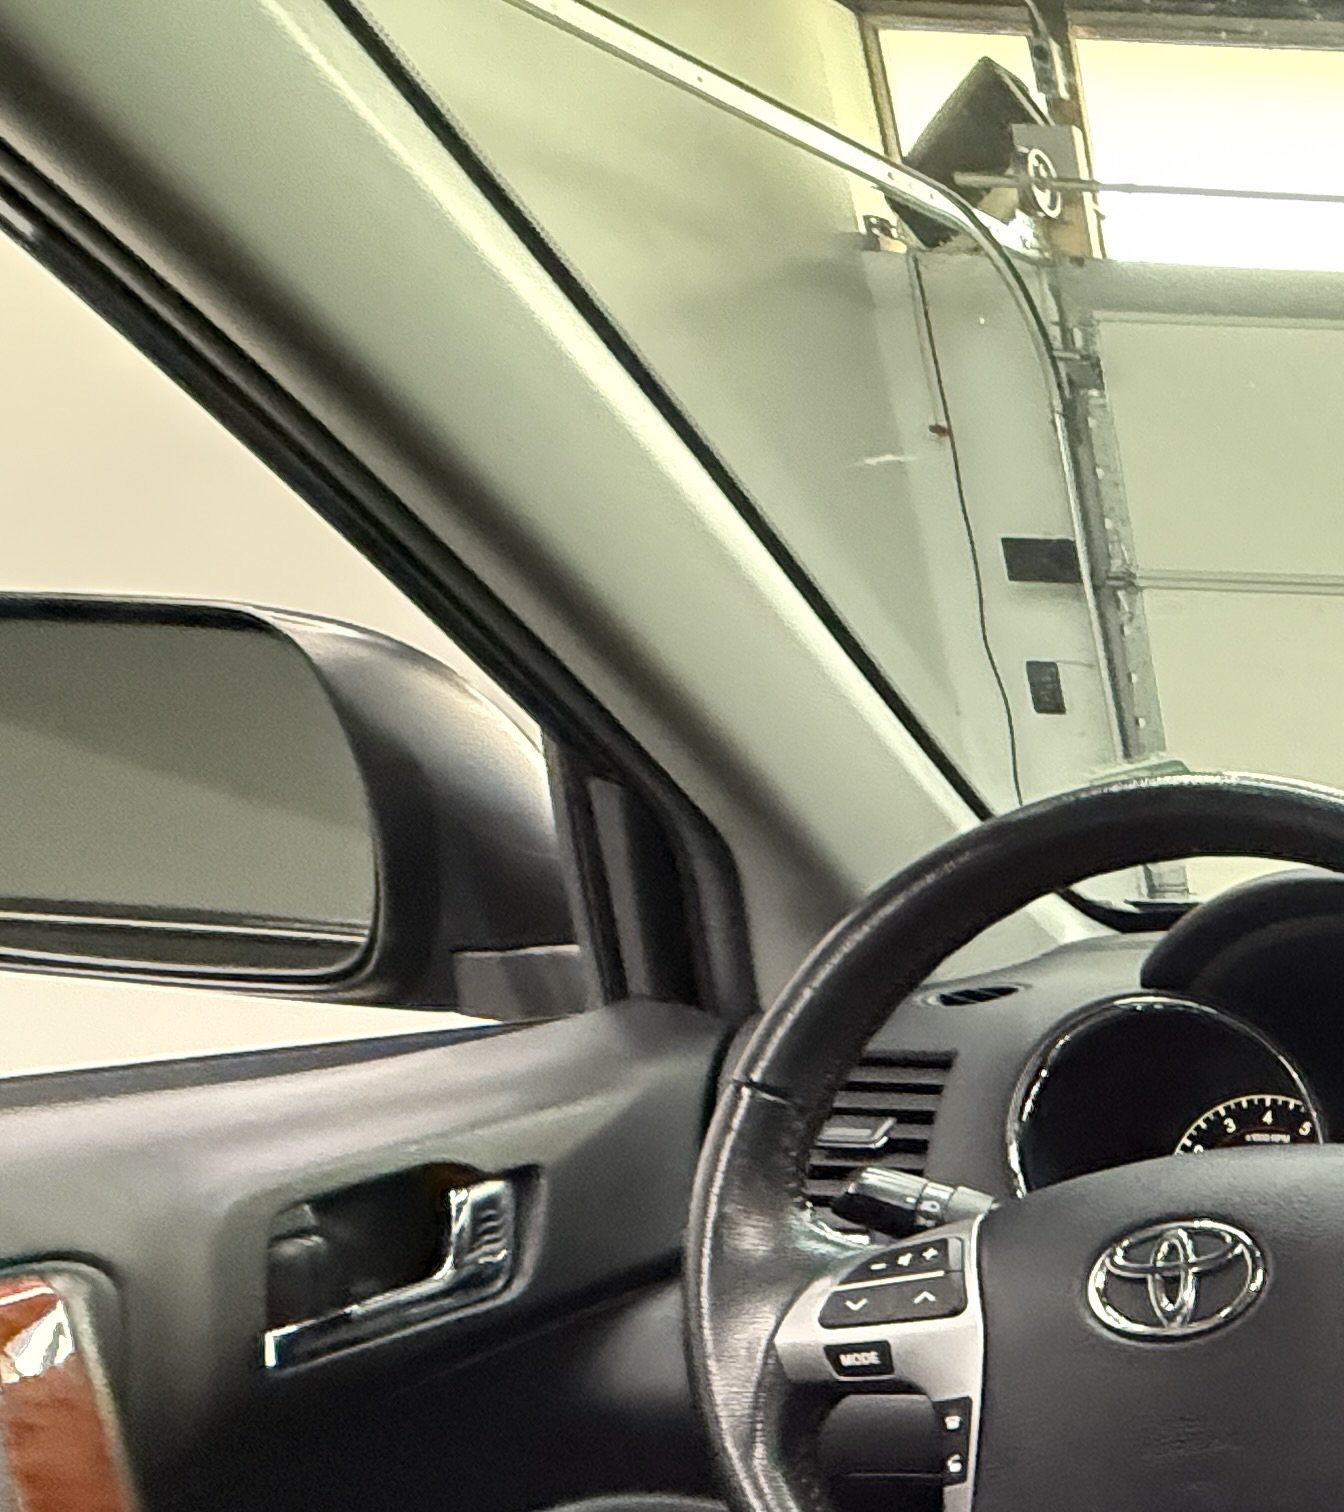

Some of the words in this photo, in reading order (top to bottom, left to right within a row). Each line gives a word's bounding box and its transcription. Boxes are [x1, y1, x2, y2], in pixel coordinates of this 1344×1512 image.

[1261, 1109, 1273, 1125] 4
[1223, 1117, 1237, 1134] 3
[1298, 1120, 1313, 1137] 5
[839, 1351, 881, 1367] MODE
